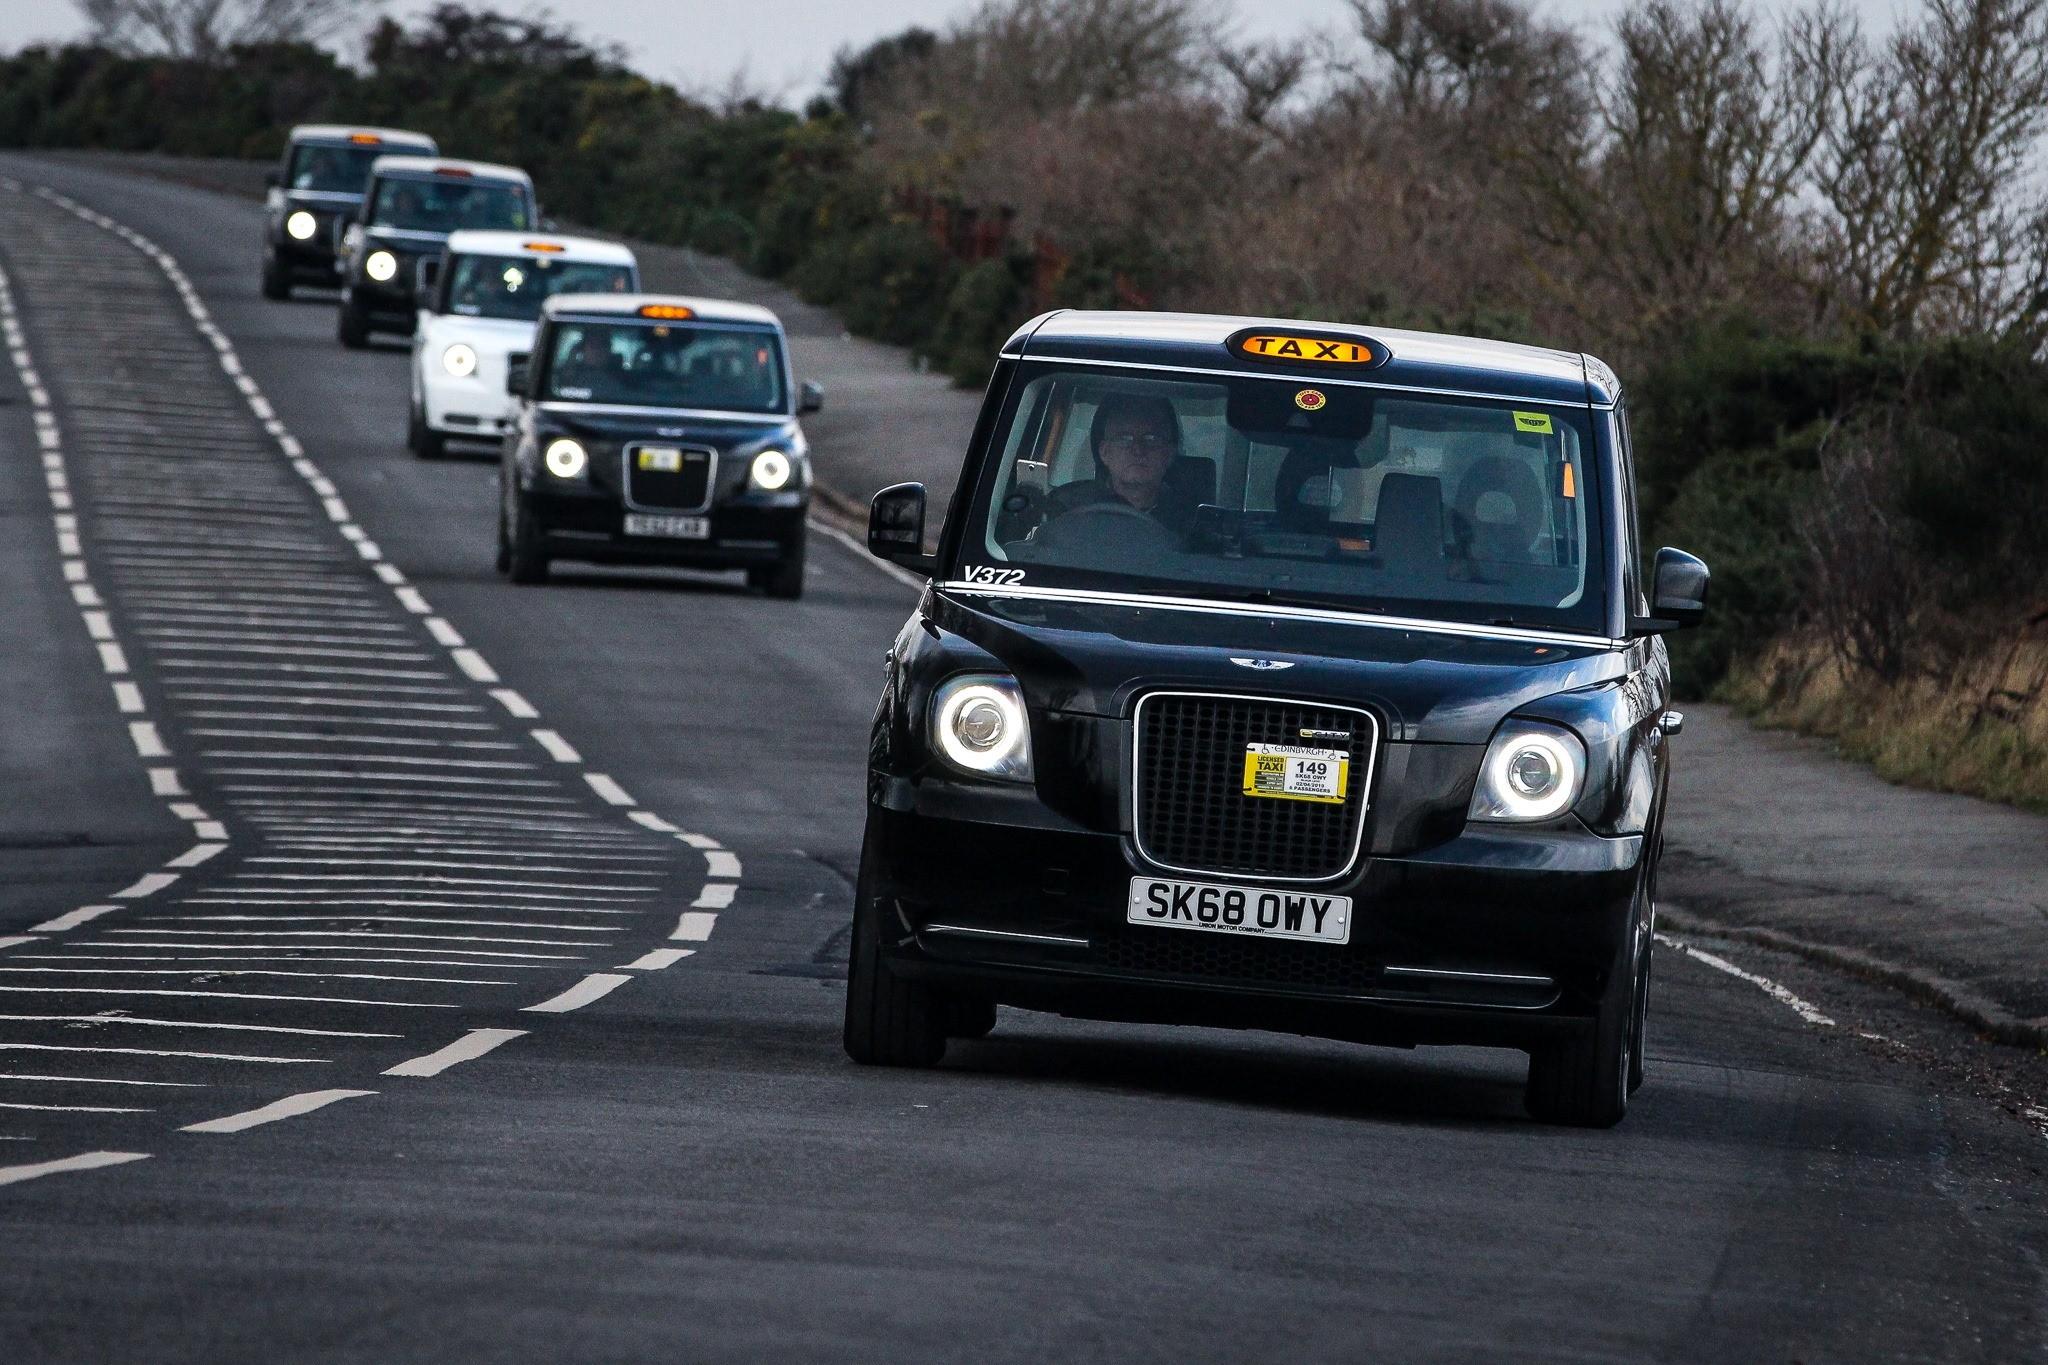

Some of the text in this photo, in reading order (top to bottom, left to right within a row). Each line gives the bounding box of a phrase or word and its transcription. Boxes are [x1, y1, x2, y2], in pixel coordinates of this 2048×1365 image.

[1255, 338, 1359, 361] TAXI
[964, 565, 1026, 586] V372
[1257, 761, 1284, 771] TAXI
[1296, 761, 1327, 775] 149
[1146, 883, 1332, 934] SK68 OWY
